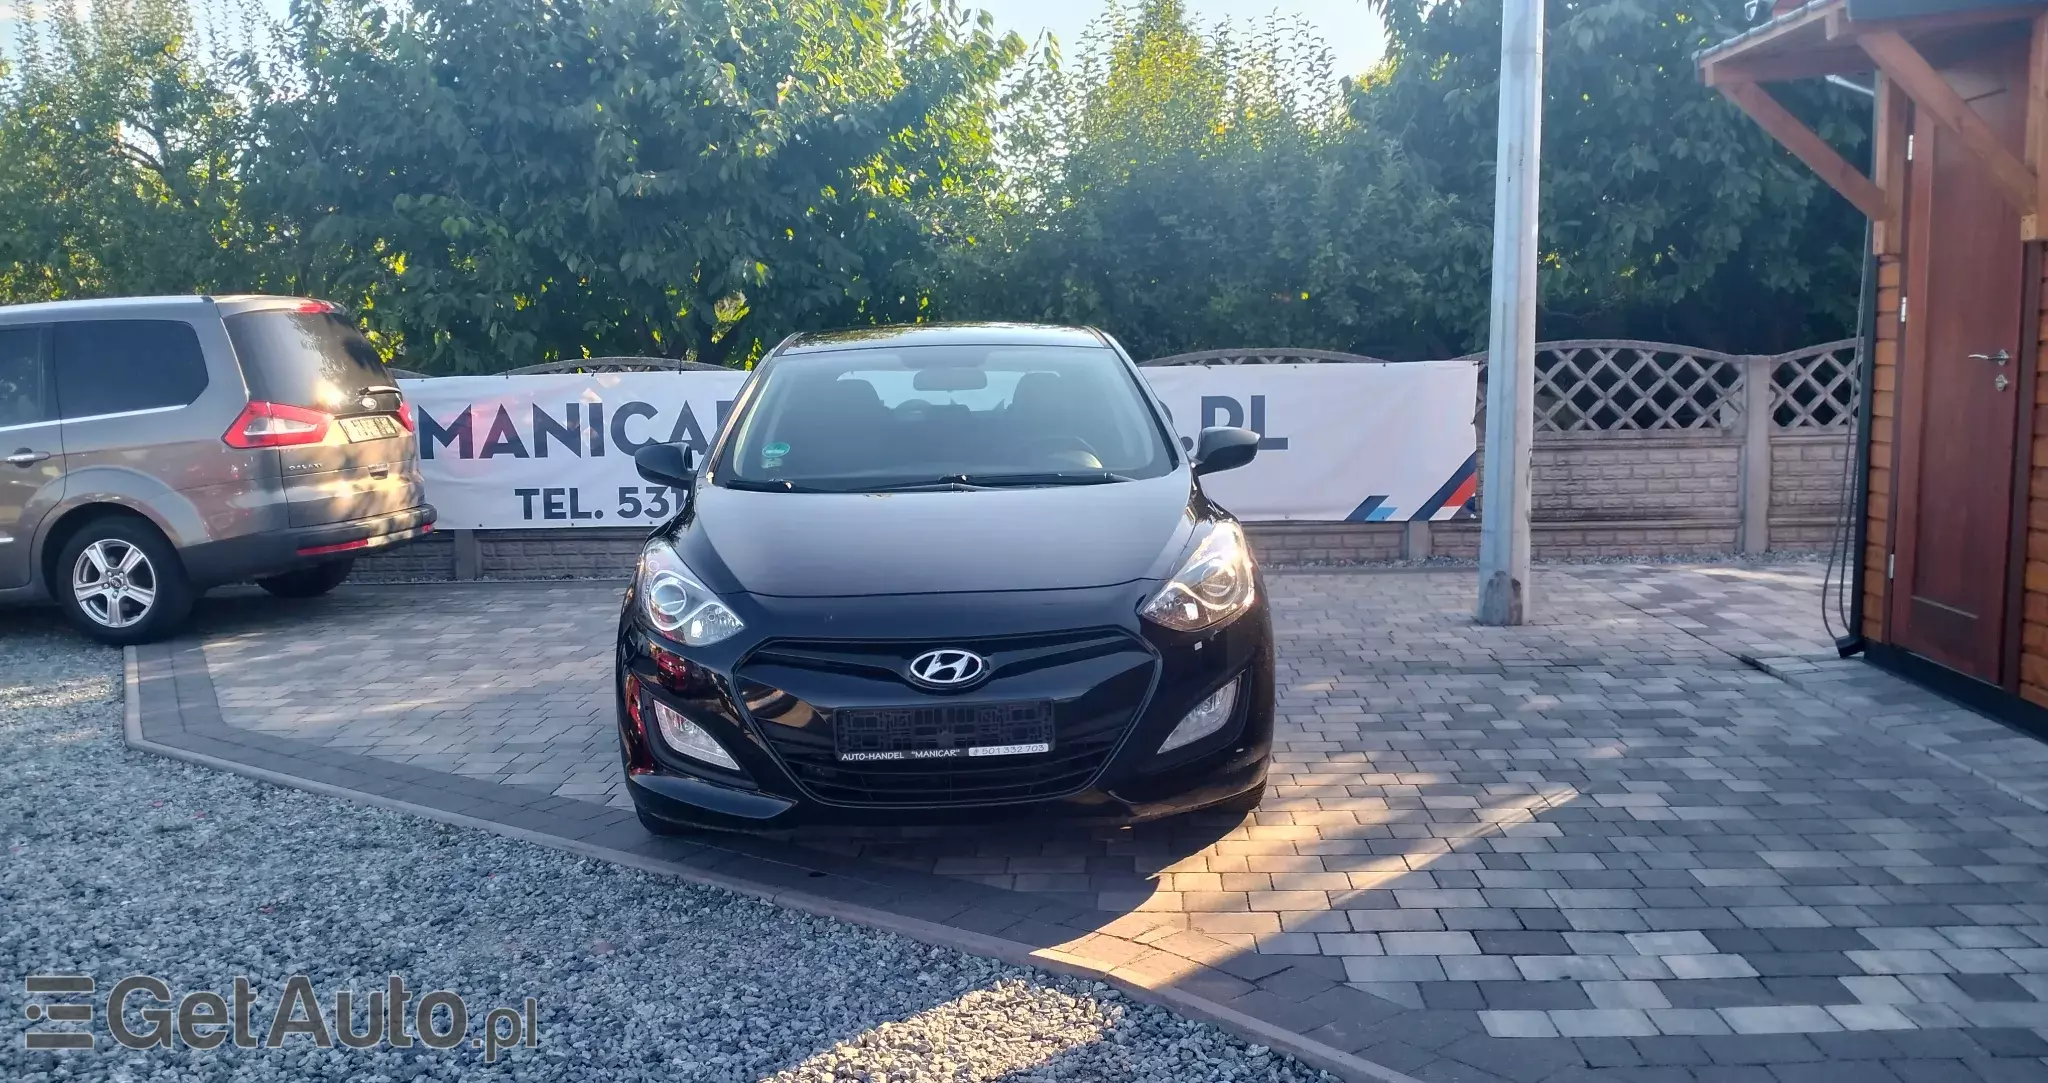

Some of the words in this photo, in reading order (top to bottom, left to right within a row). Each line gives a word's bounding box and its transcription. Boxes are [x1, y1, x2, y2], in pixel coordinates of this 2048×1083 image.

[1158, 394, 1288, 451] .PL
[514, 488, 604, 520] TEL.
[841, 752, 905, 761] AUTO-HANDEL
[982, 747, 1001, 755] 501
[1003, 746, 1023, 754] 332
[1025, 744, 1045, 753] 703
